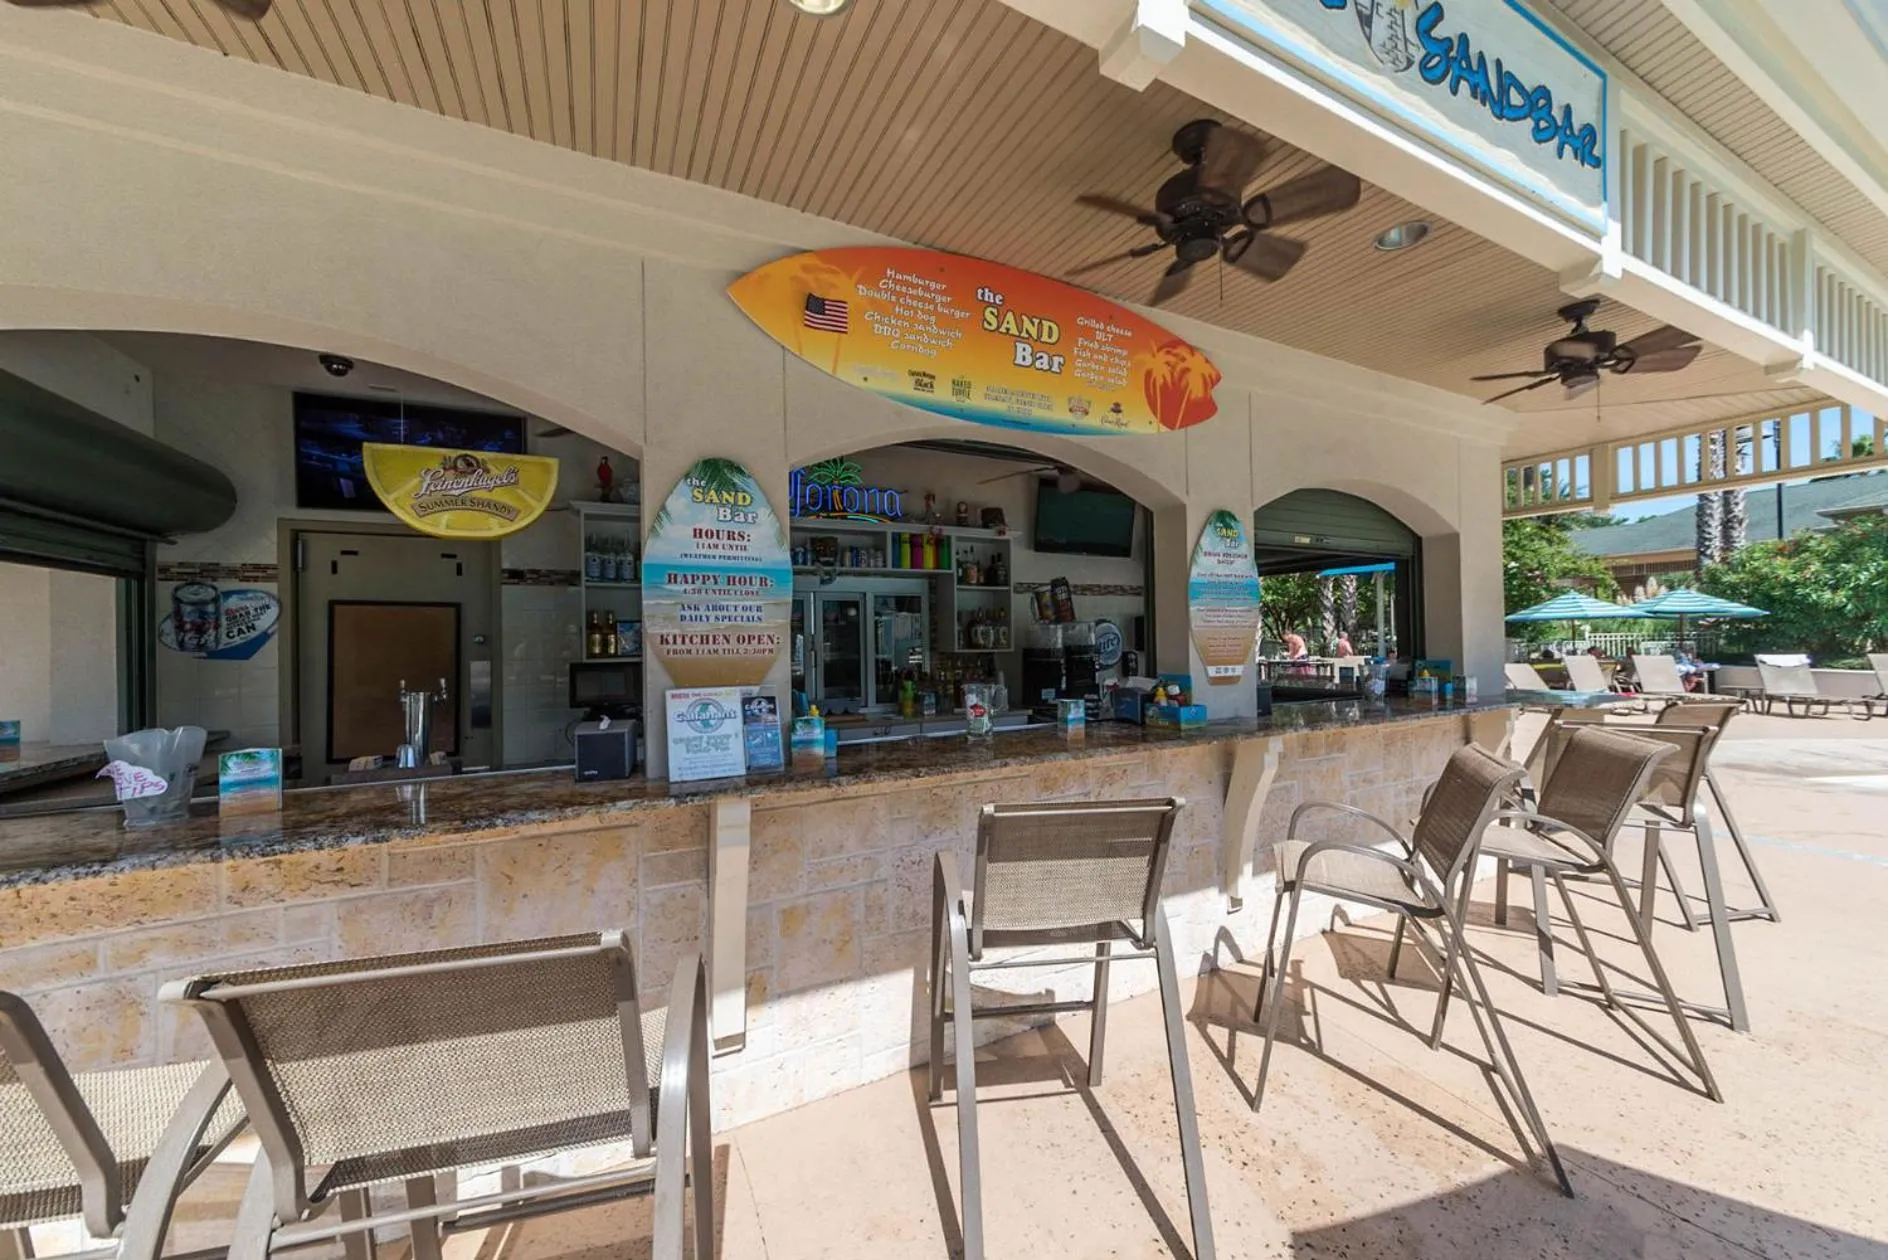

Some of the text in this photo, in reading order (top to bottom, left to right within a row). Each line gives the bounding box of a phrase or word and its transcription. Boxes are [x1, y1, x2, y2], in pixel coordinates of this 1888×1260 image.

[886, 267, 947, 290] Hamburger
[879, 279, 953, 303] Cheeseburger
[976, 286, 1004, 306] the
[857, 284, 971, 320] Double cheese burger
[895, 305, 937, 325] Hot dog
[1077, 316, 1104, 330] Grilled
[864, 311, 962, 339] Chicken sandwich
[982, 305, 1060, 345] SAND
[874, 323, 953, 349] BBQ sandwich
[1013, 340, 1065, 374] Bar
[686, 477, 706, 488] the
[692, 487, 753, 506] SAND
[717, 506, 758, 524] Bar
[693, 528, 751, 542] HOURS:
[667, 573, 774, 587] HAPPY HOUR:
[680, 603, 763, 613] ASK ABOUT OUR
[680, 614, 762, 623] DAILY SPECIALS
[226, 622, 257, 639] CAN
[660, 634, 780, 645] KITCHEN OPEN:
